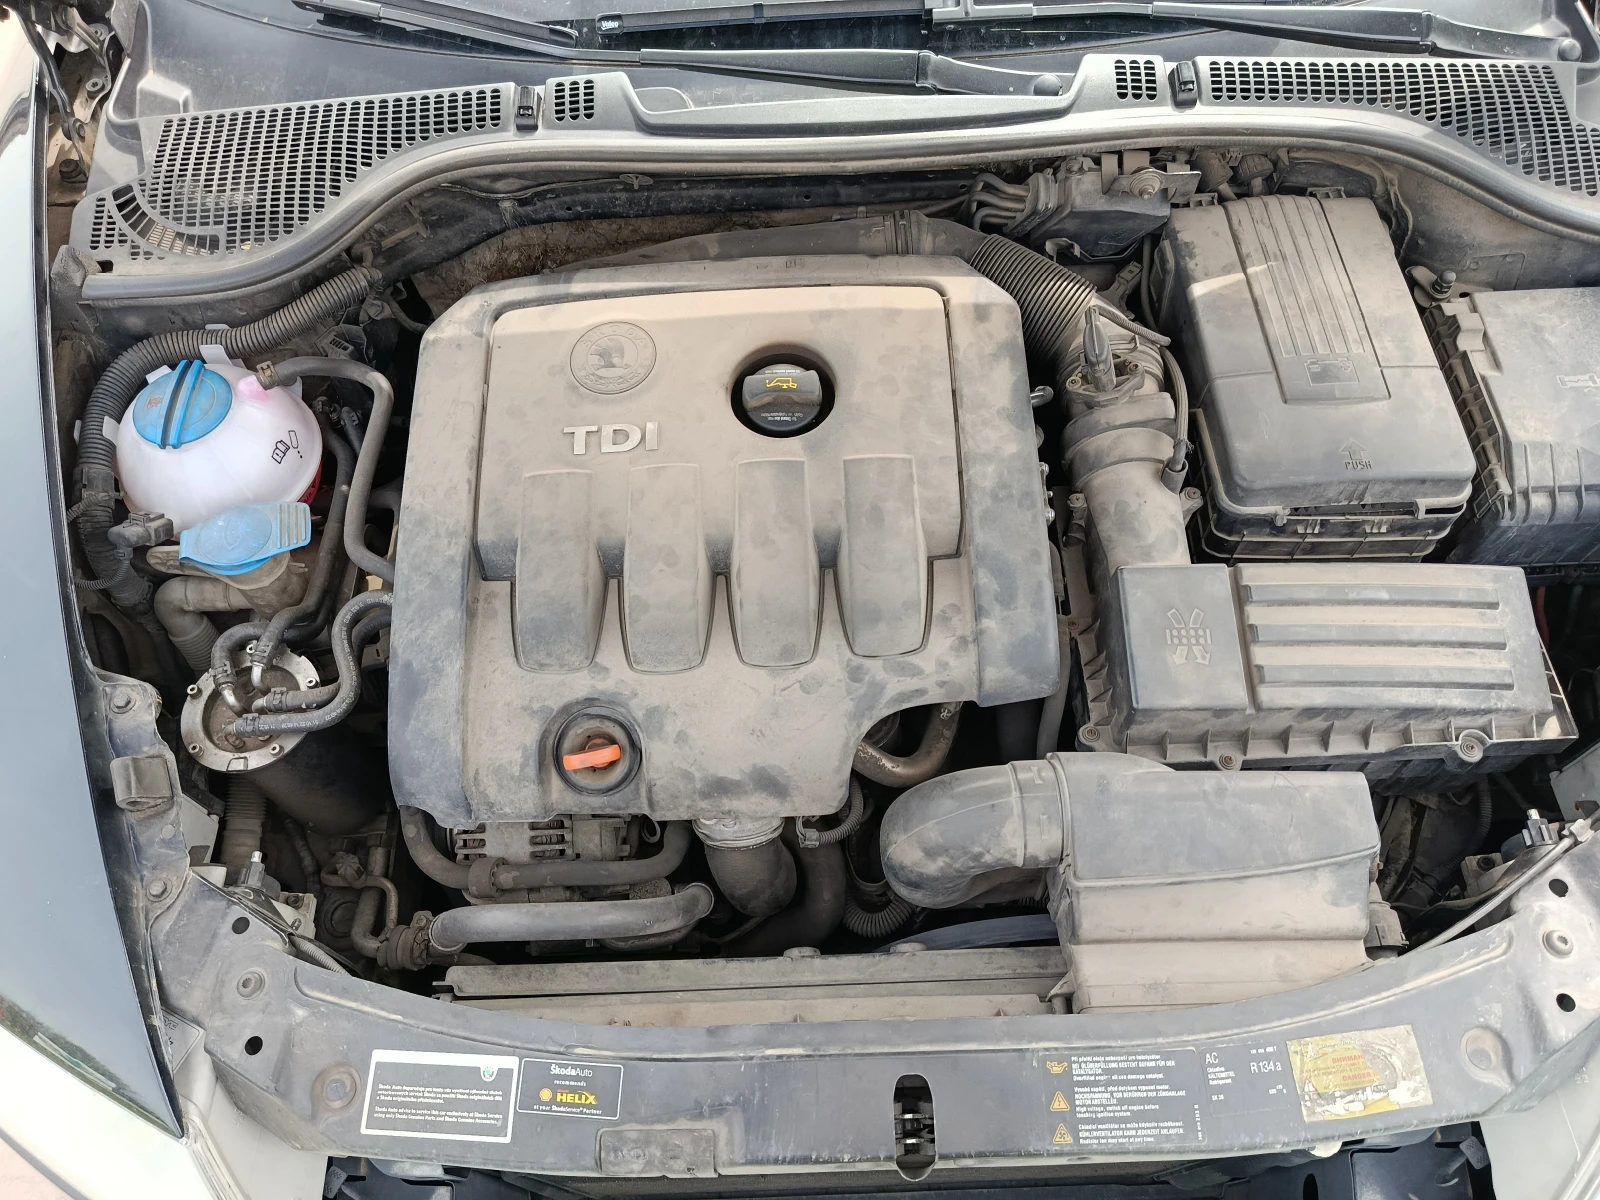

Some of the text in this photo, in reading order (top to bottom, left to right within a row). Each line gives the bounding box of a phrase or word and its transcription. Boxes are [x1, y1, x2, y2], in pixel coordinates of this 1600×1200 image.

[601, 20, 619, 30] Valeo
[563, 422, 659, 455] TDI
[1344, 460, 1372, 470] PUSH
[1206, 1052, 1219, 1064] AC
[1331, 1054, 1365, 1064] ВНИМАН
[550, 1064, 593, 1077] ŠkodaAuto
[1342, 1072, 1371, 1082] DANGER
[556, 1091, 598, 1105] HELIX
